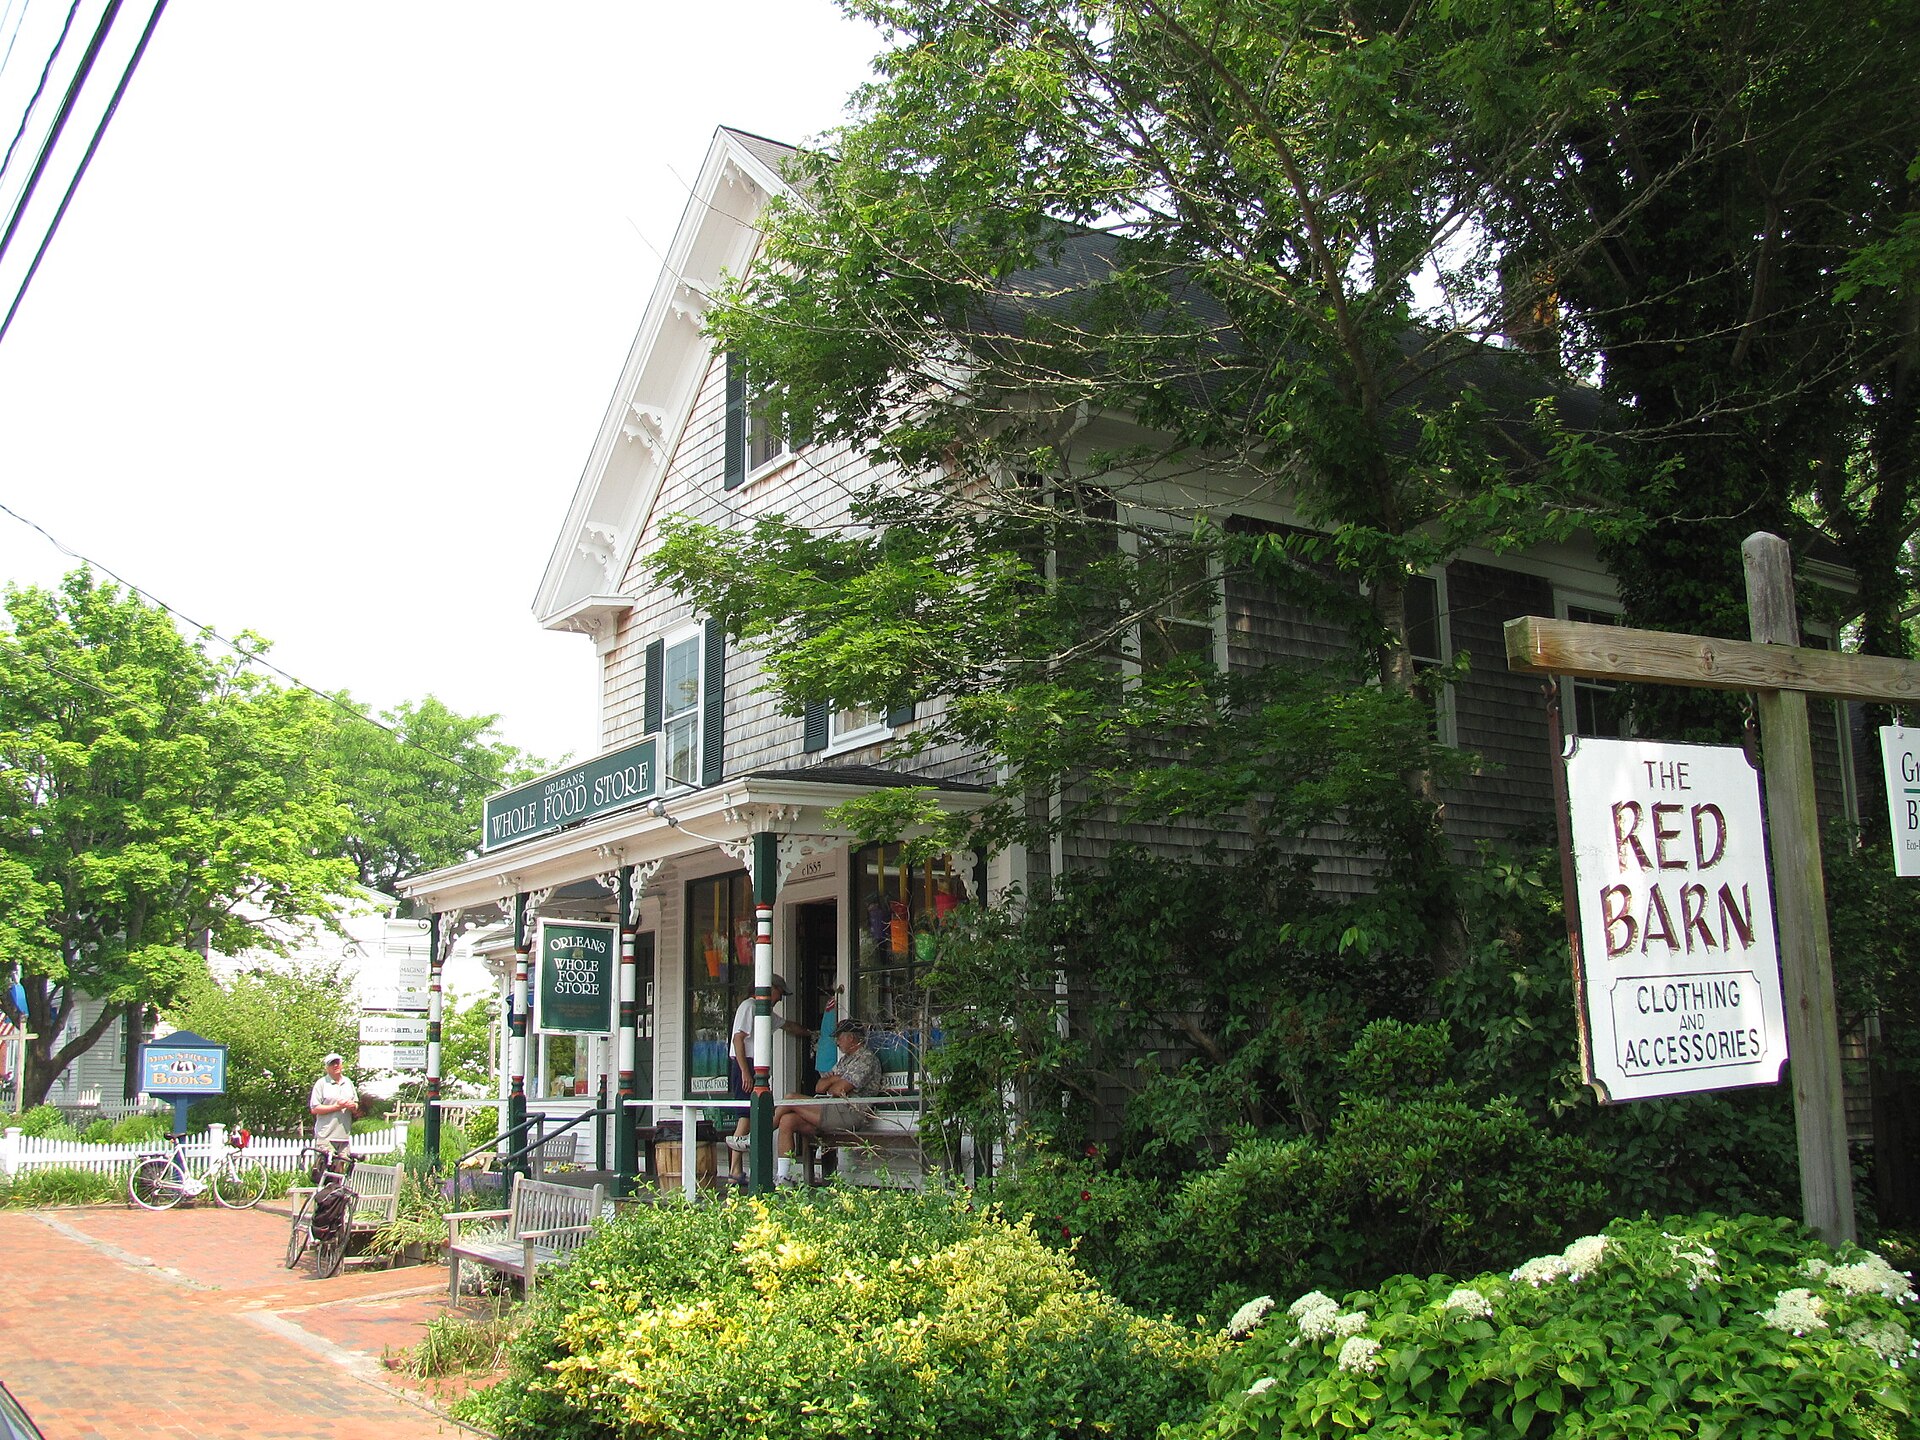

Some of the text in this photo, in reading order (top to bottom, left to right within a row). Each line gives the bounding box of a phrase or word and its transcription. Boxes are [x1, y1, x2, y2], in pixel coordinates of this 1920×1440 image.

[544, 772, 585, 796] ORLEANS
[1643, 760, 1691, 791] THE
[492, 761, 649, 839] WHOLE FOOD STORE
[1906, 799, 1920, 830] B
[1611, 801, 1728, 873] RED
[1600, 881, 1756, 960] BARN
[550, 936, 606, 953] ORLEANS
[554, 958, 599, 971] WHOLE
[558, 970, 596, 983] FOOD
[554, 982, 600, 995] STORE
[1637, 980, 1741, 1014] CLOTHING
[1679, 1012, 1705, 1031] AND
[1624, 1028, 1760, 1069] ACCESSORIES
